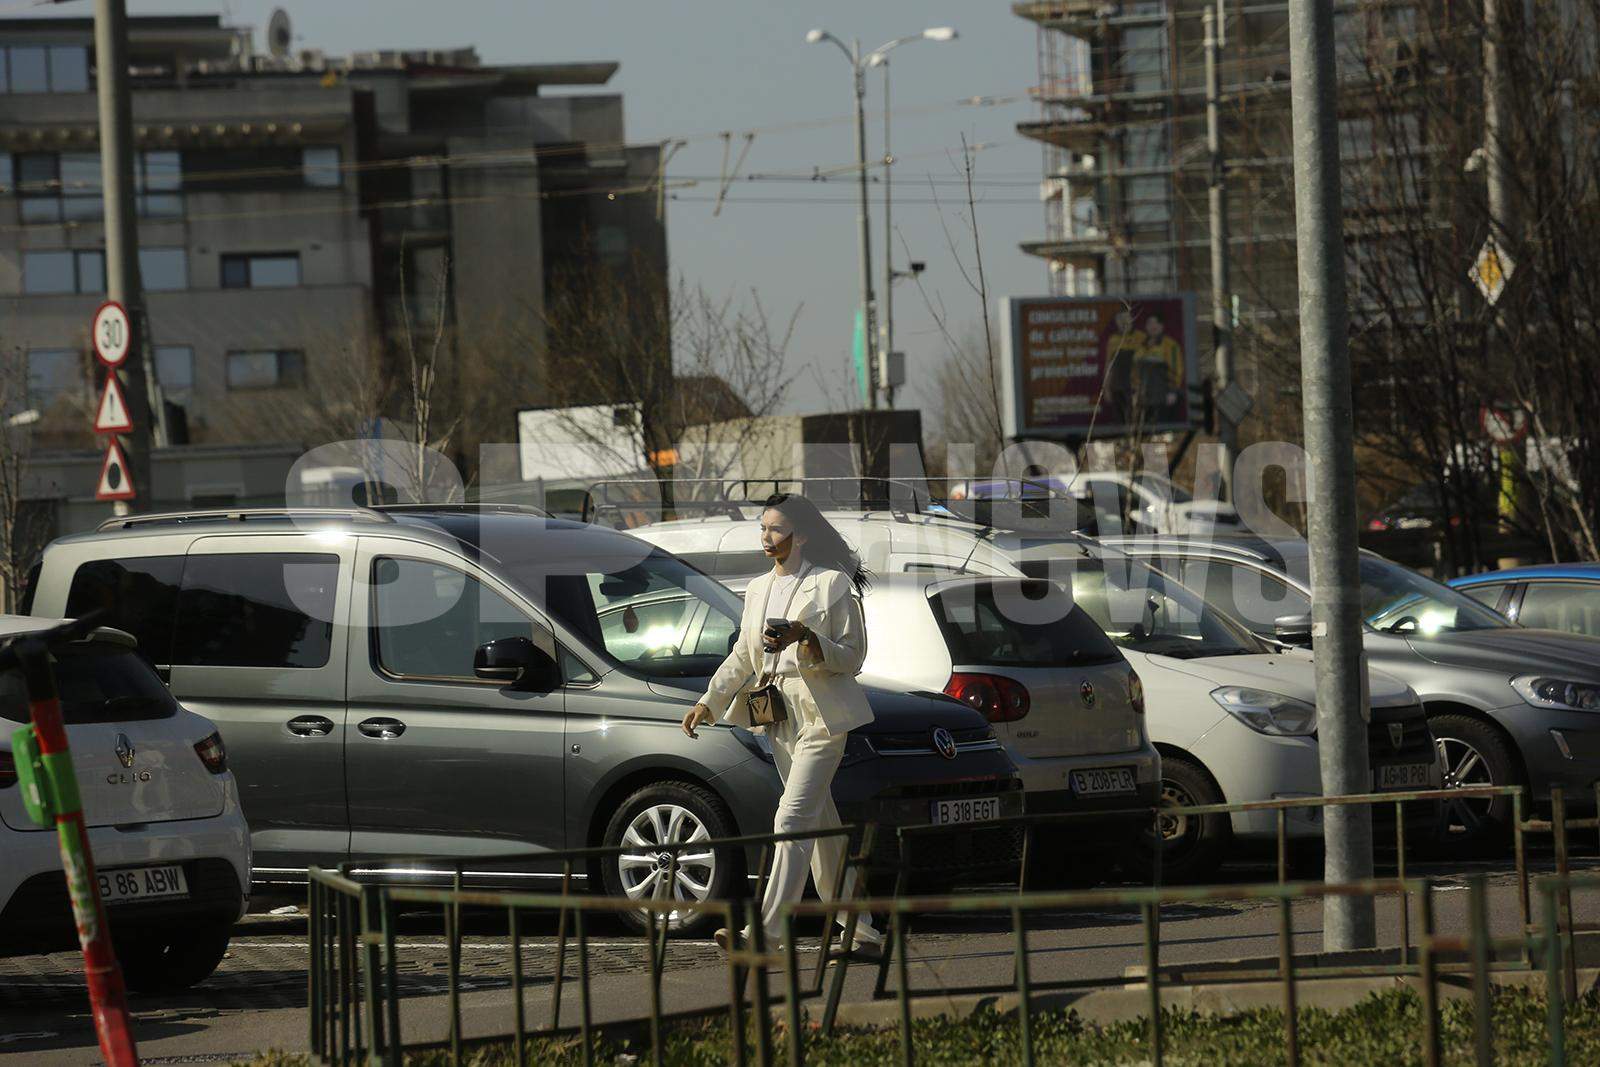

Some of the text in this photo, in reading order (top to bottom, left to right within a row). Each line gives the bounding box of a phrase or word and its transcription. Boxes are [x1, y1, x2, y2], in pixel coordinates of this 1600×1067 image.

[101, 319, 123, 350] 30
[106, 770, 152, 785] CLIO
[1075, 773, 1088, 792] B
[940, 800, 996, 824] B 318 EGT
[99, 867, 180, 898] B 86 ABW
